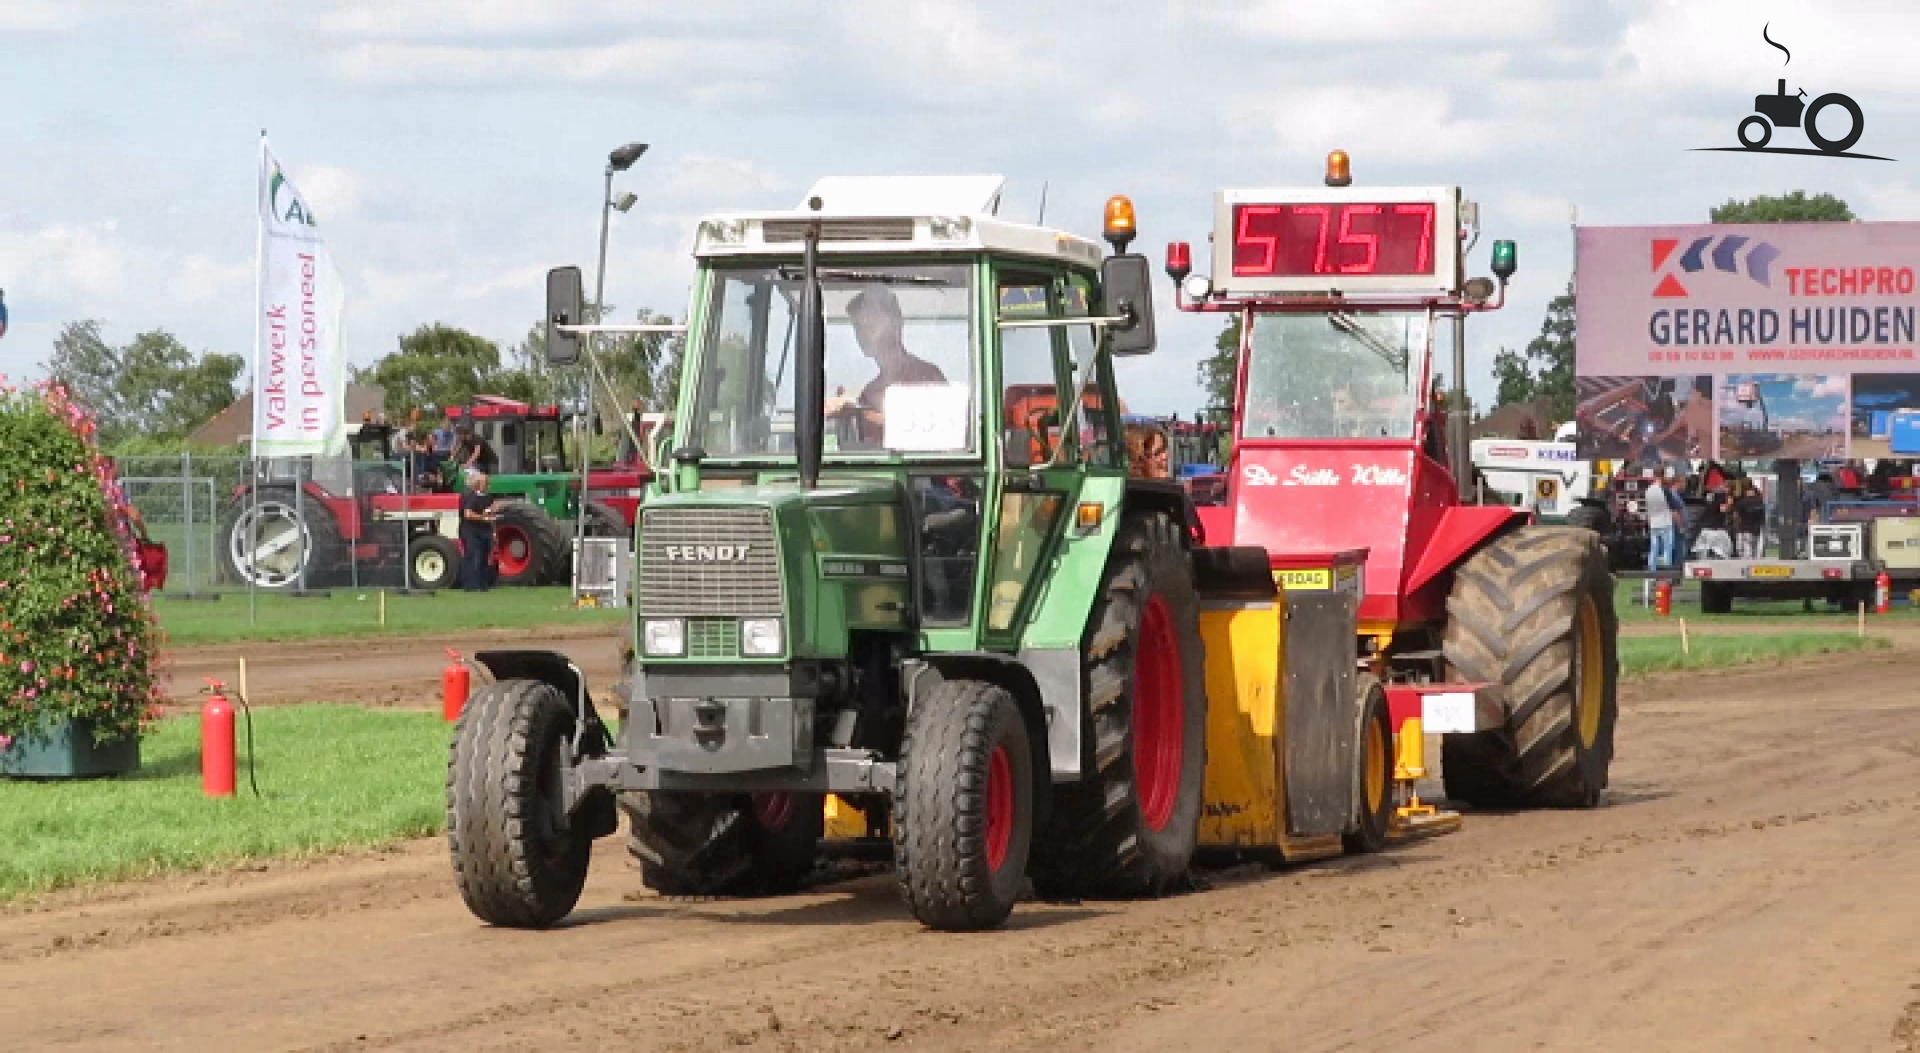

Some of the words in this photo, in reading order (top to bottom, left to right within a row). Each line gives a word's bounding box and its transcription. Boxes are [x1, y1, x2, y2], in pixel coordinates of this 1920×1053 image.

[1785, 268, 1914, 296] TECHPRO
[297, 252, 326, 396] personeel
[1650, 308, 1780, 345] GERARD
[1790, 307, 1915, 344] HUIDEN
[298, 406, 320, 432] in
[1242, 464, 1279, 485] De
[665, 545, 751, 561] FENDT
